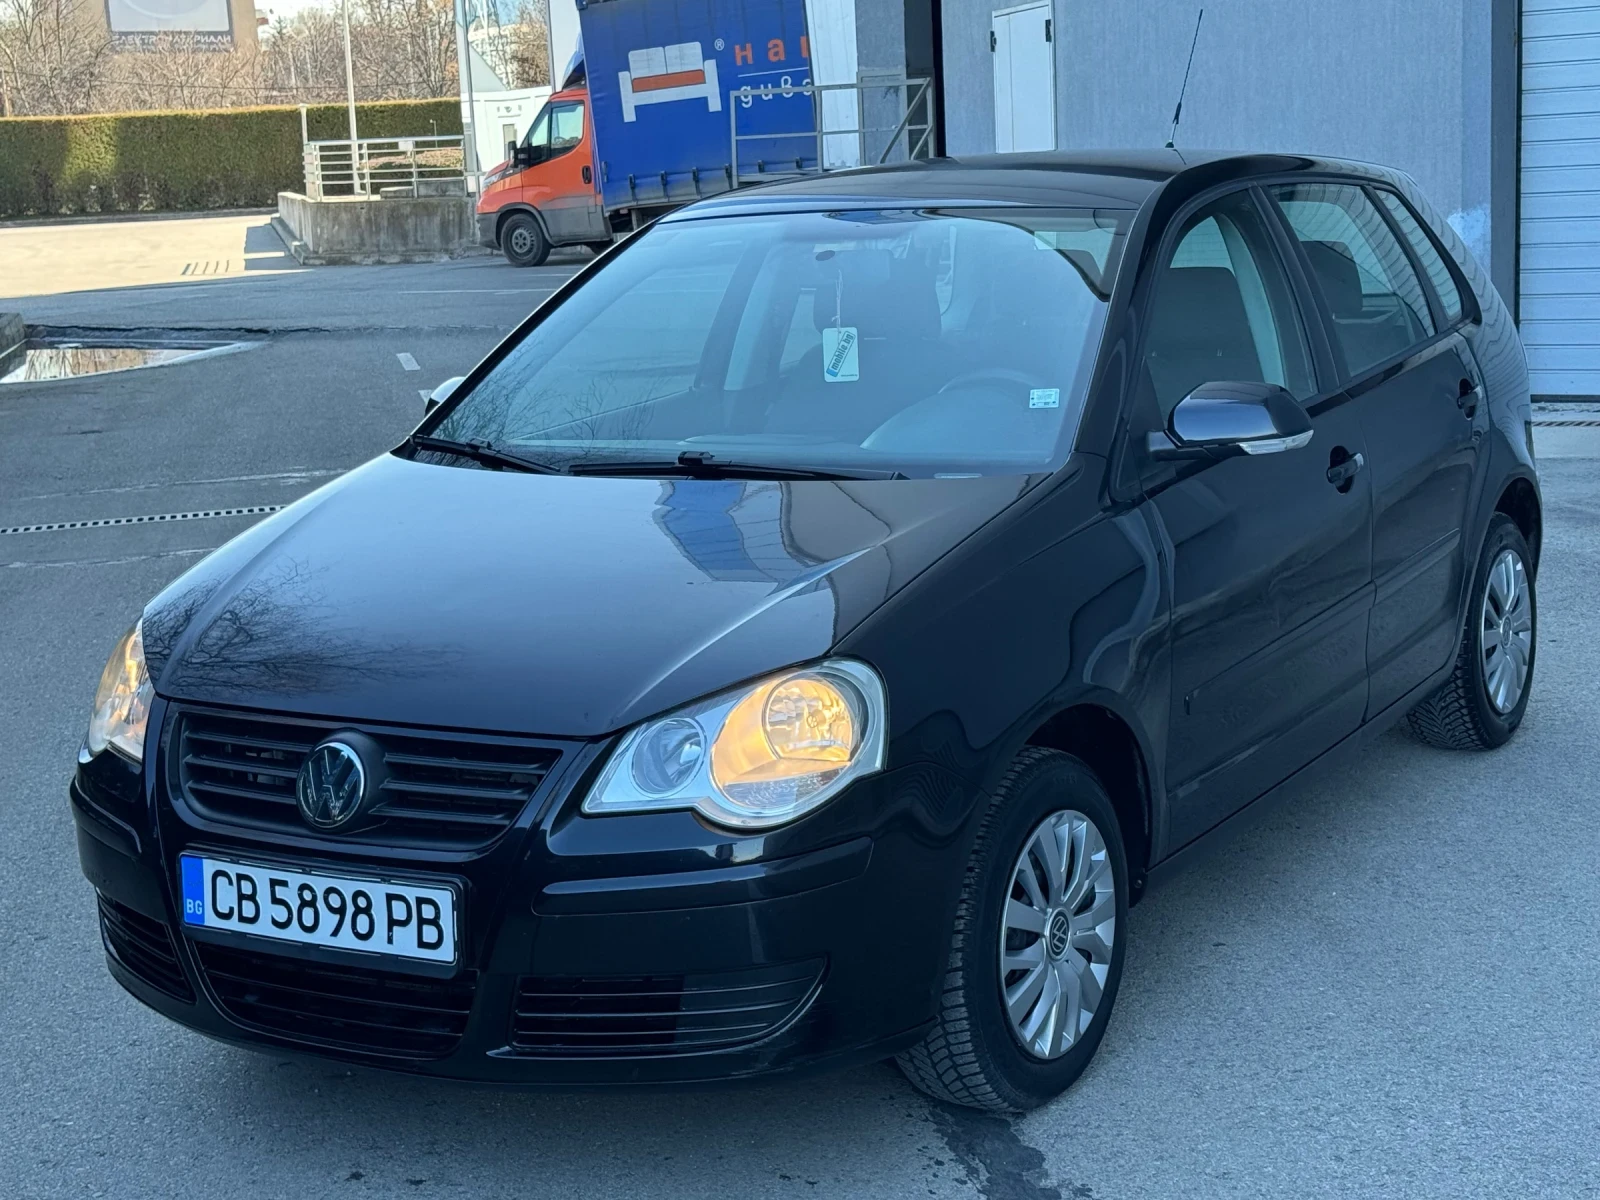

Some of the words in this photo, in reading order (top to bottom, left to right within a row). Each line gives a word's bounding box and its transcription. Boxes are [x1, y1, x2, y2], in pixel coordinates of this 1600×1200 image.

[112, 34, 232, 44] ЕЛЕКТРАТЕРИАЛИ
[831, 333, 855, 370] mobile.bg
[186, 898, 203, 915] BG
